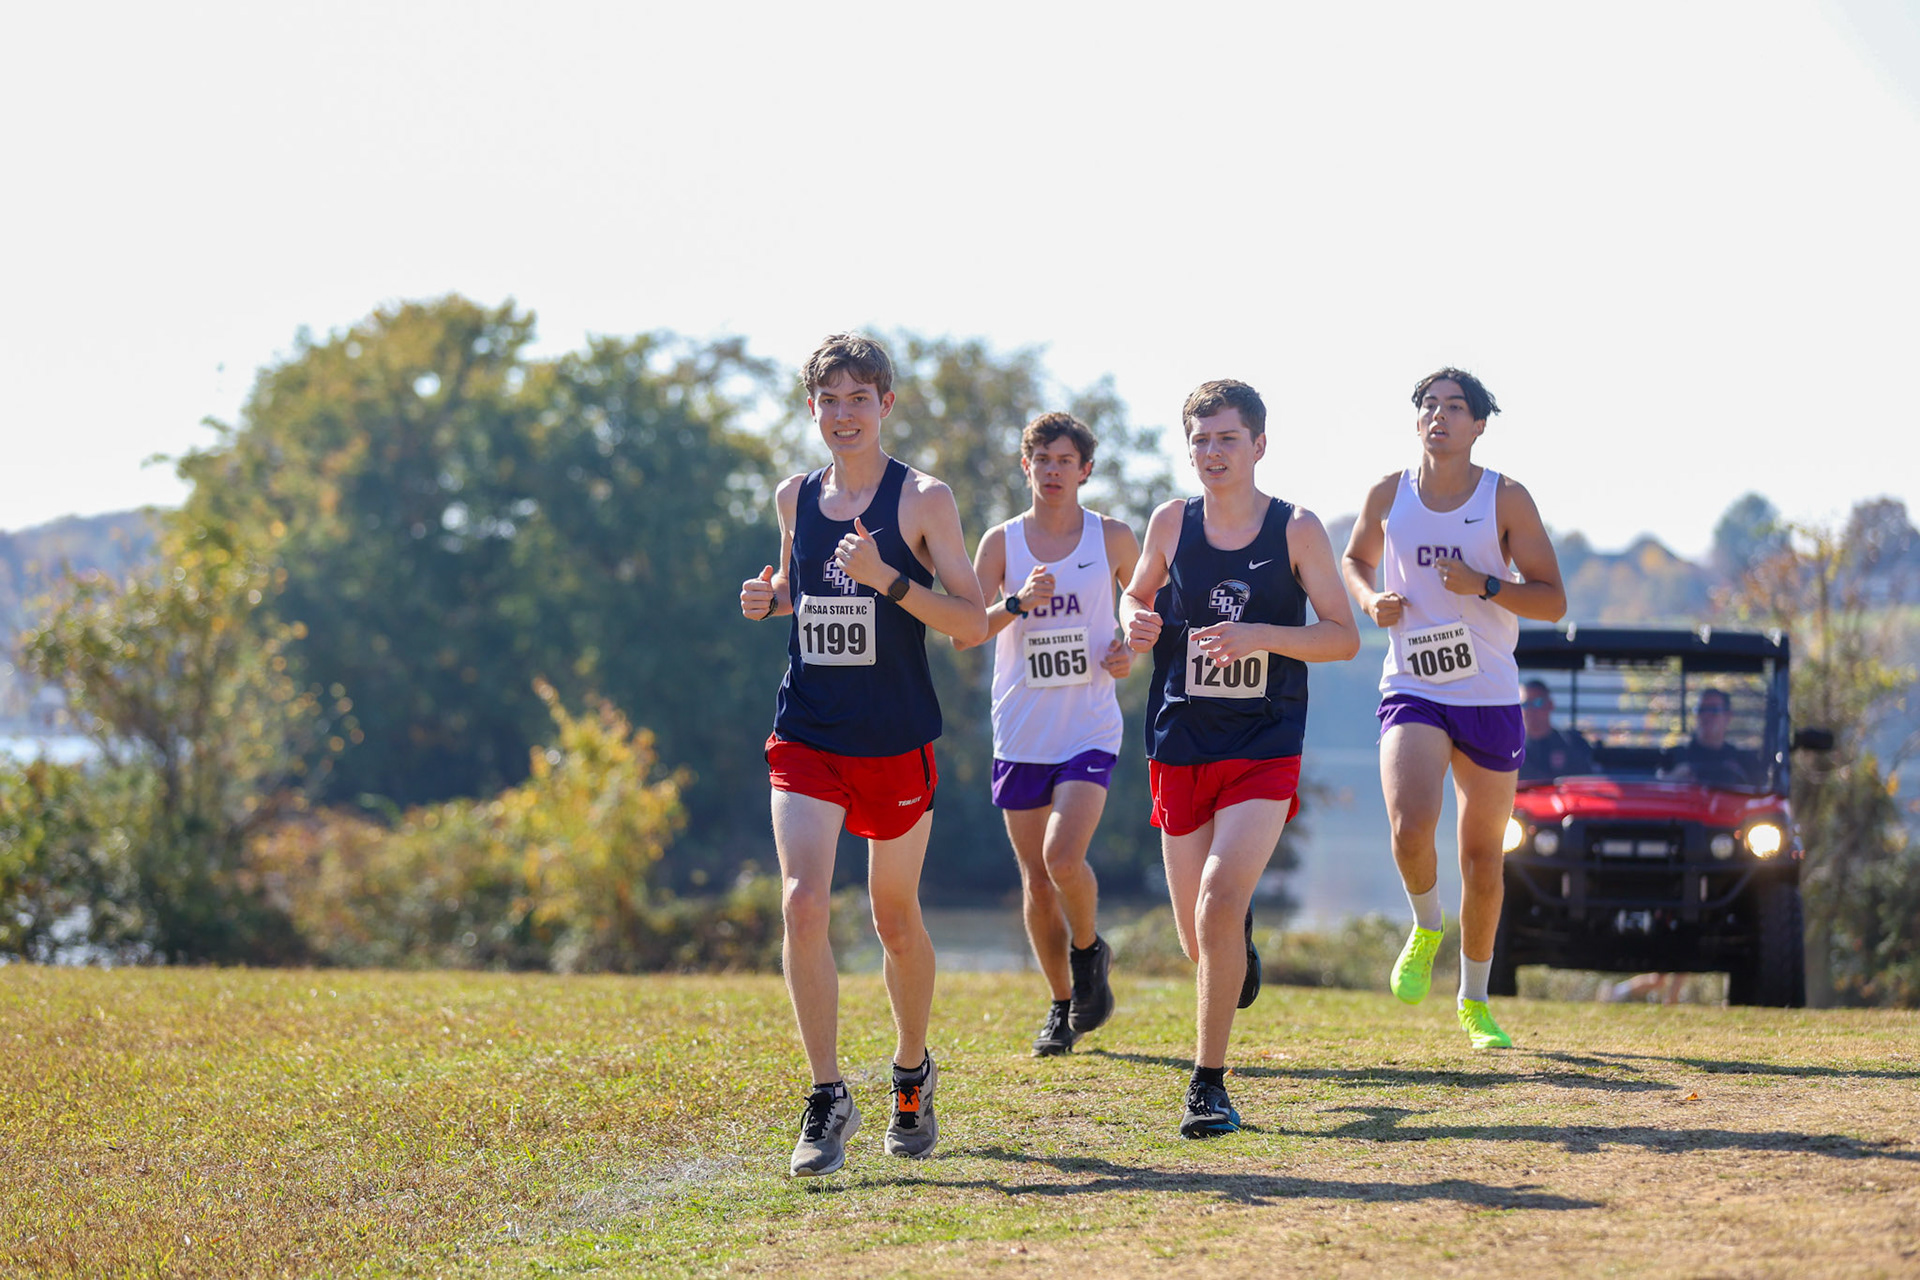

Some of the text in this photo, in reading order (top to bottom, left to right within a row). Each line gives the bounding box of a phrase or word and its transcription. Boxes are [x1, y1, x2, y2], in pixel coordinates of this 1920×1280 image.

[824, 560, 857, 595] SBA
[804, 604, 867, 615] TMSAA STATE XC
[1211, 588, 1242, 621] SBA
[803, 622, 866, 655] 1199
[1052, 634, 1073, 644] STATE
[1408, 628, 1464, 646] TMSAA STATE XC
[1028, 649, 1087, 678] 1065
[1192, 655, 1261, 688] 1200
[1407, 643, 1472, 677] 1068
